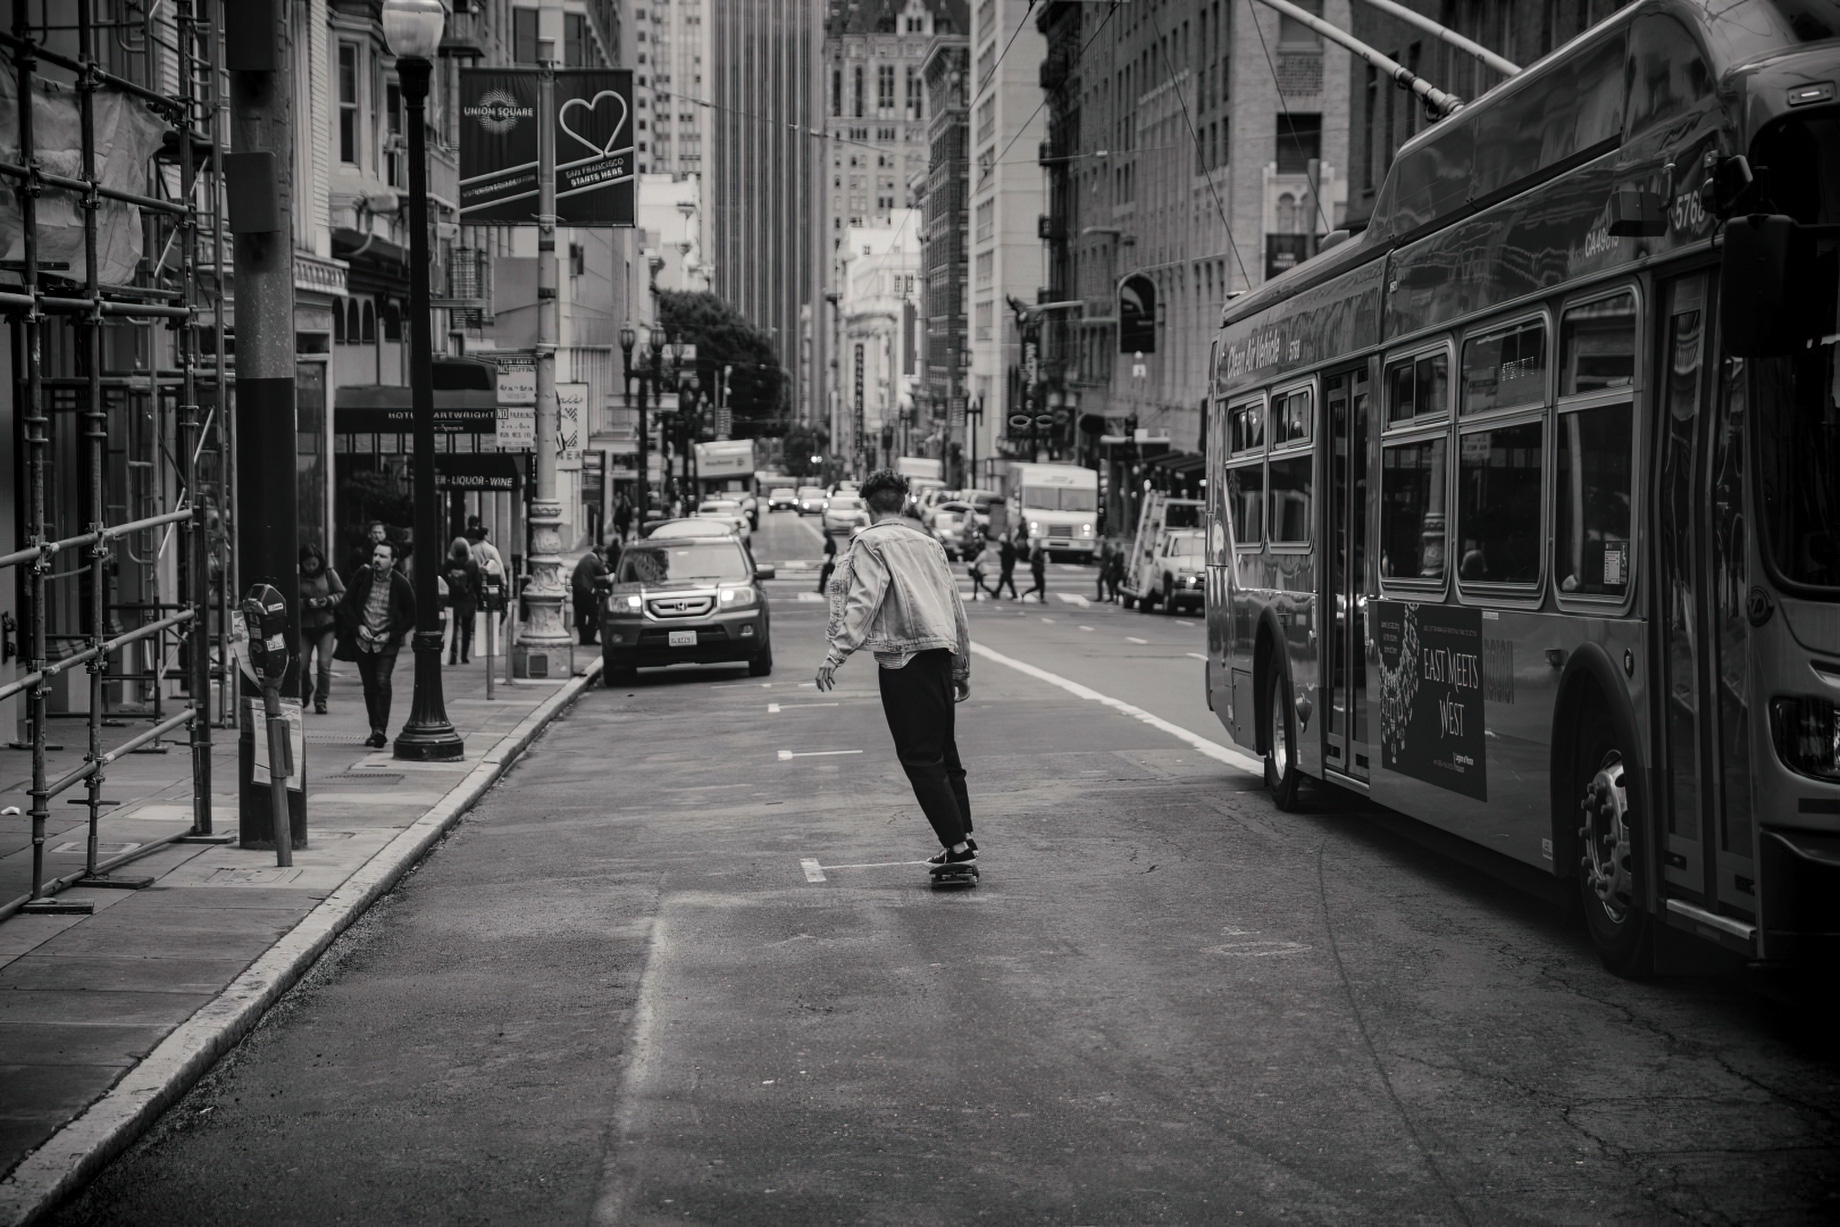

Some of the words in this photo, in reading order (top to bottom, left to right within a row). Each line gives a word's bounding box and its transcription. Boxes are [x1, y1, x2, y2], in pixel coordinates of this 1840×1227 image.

[464, 106, 496, 117] UNION
[497, 106, 534, 118] SQUARE
[1227, 345, 1246, 380] Clean
[1244, 338, 1257, 374] Air
[1255, 328, 1281, 370] Vehicle
[433, 411, 496, 419] ARTWRIGHT
[451, 475, 485, 487] LIQUOR
[489, 477, 514, 488] WINE
[1423, 647, 1446, 683] EAST
[1446, 646, 1479, 694] MEETS
[1438, 691, 1465, 739] WEST
